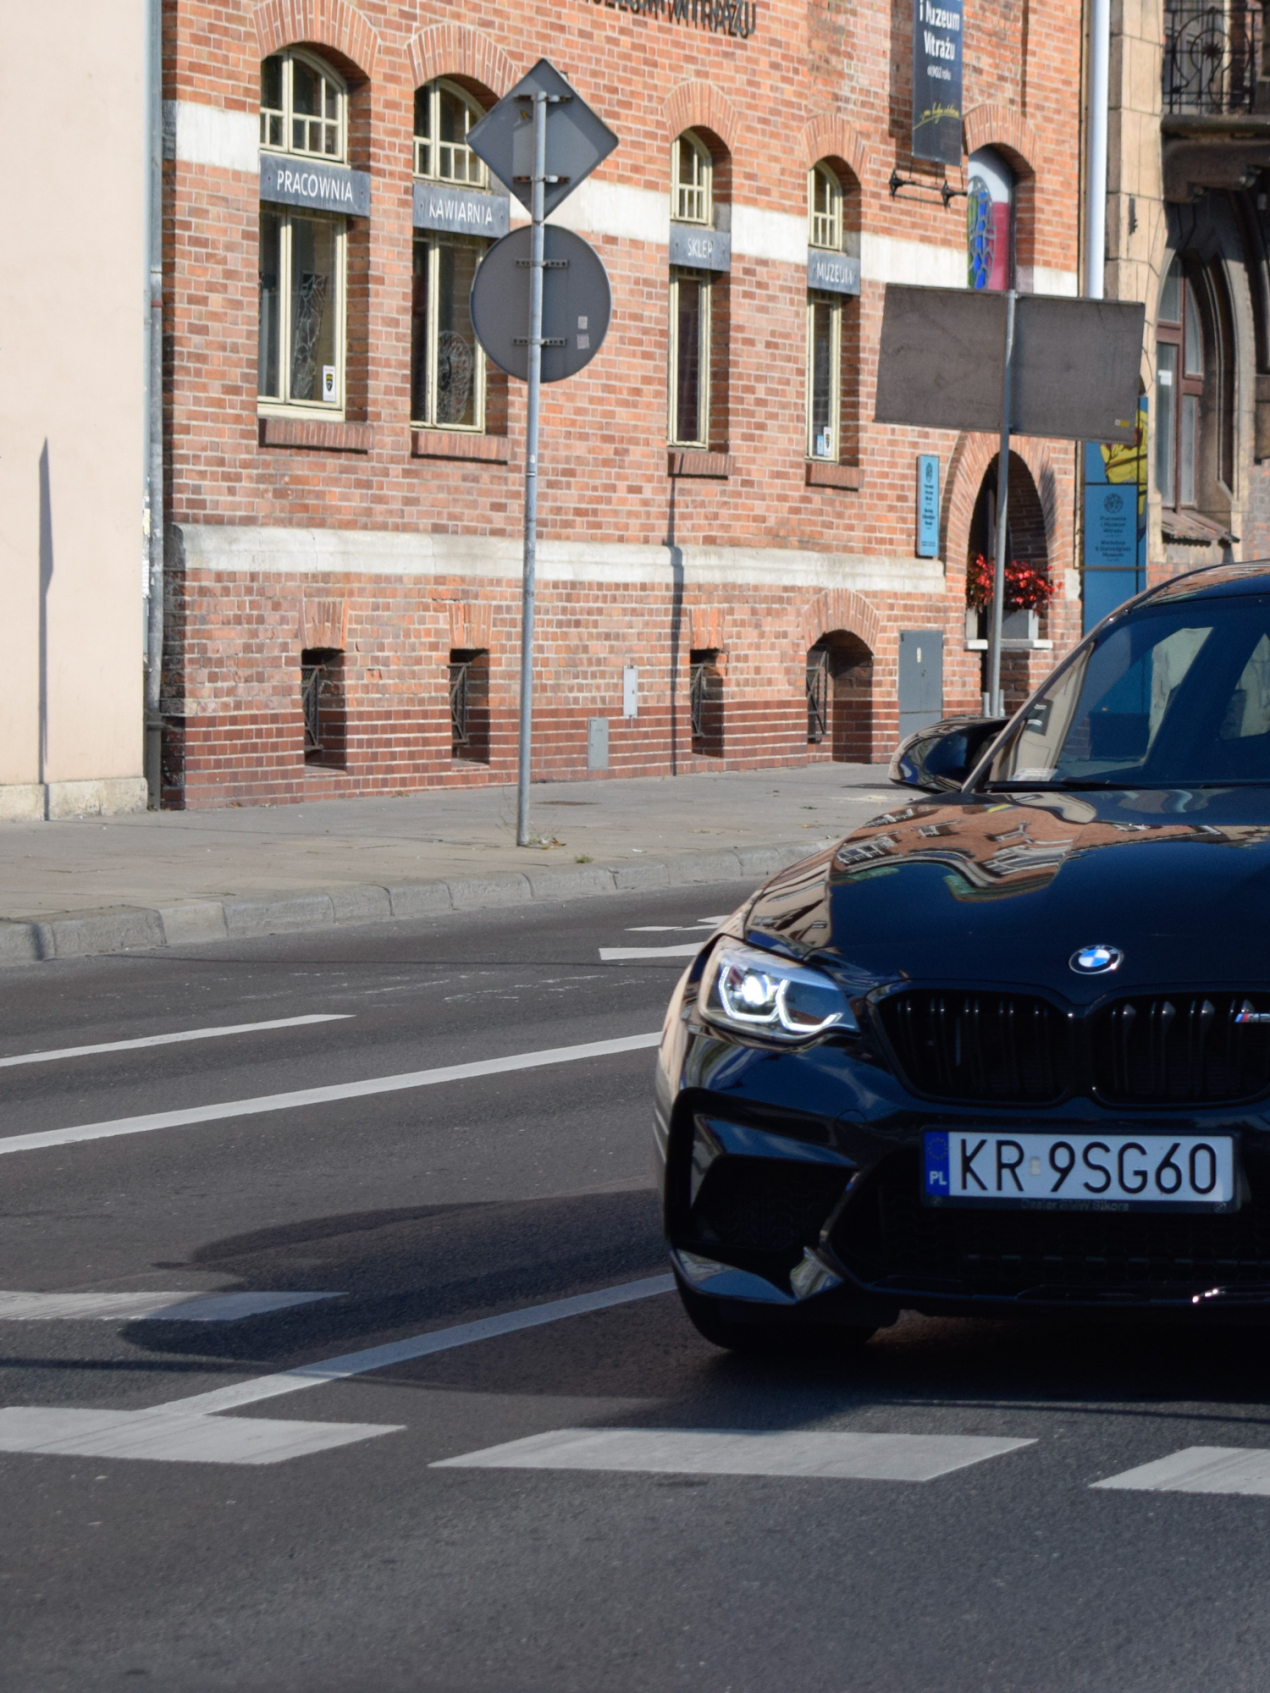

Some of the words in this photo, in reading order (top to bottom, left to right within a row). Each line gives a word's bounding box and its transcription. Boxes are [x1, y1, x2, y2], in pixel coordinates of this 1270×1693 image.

[277, 170, 353, 202] PRACOWNIA
[429, 198, 493, 225] KAWIARNIA
[687, 237, 713, 258] SKLEP
[816, 261, 853, 285] MUZEUM
[929, 1171, 947, 1185] PL
[960, 1138, 1025, 1191] KR
[1049, 1140, 1218, 1194] 9SG60
